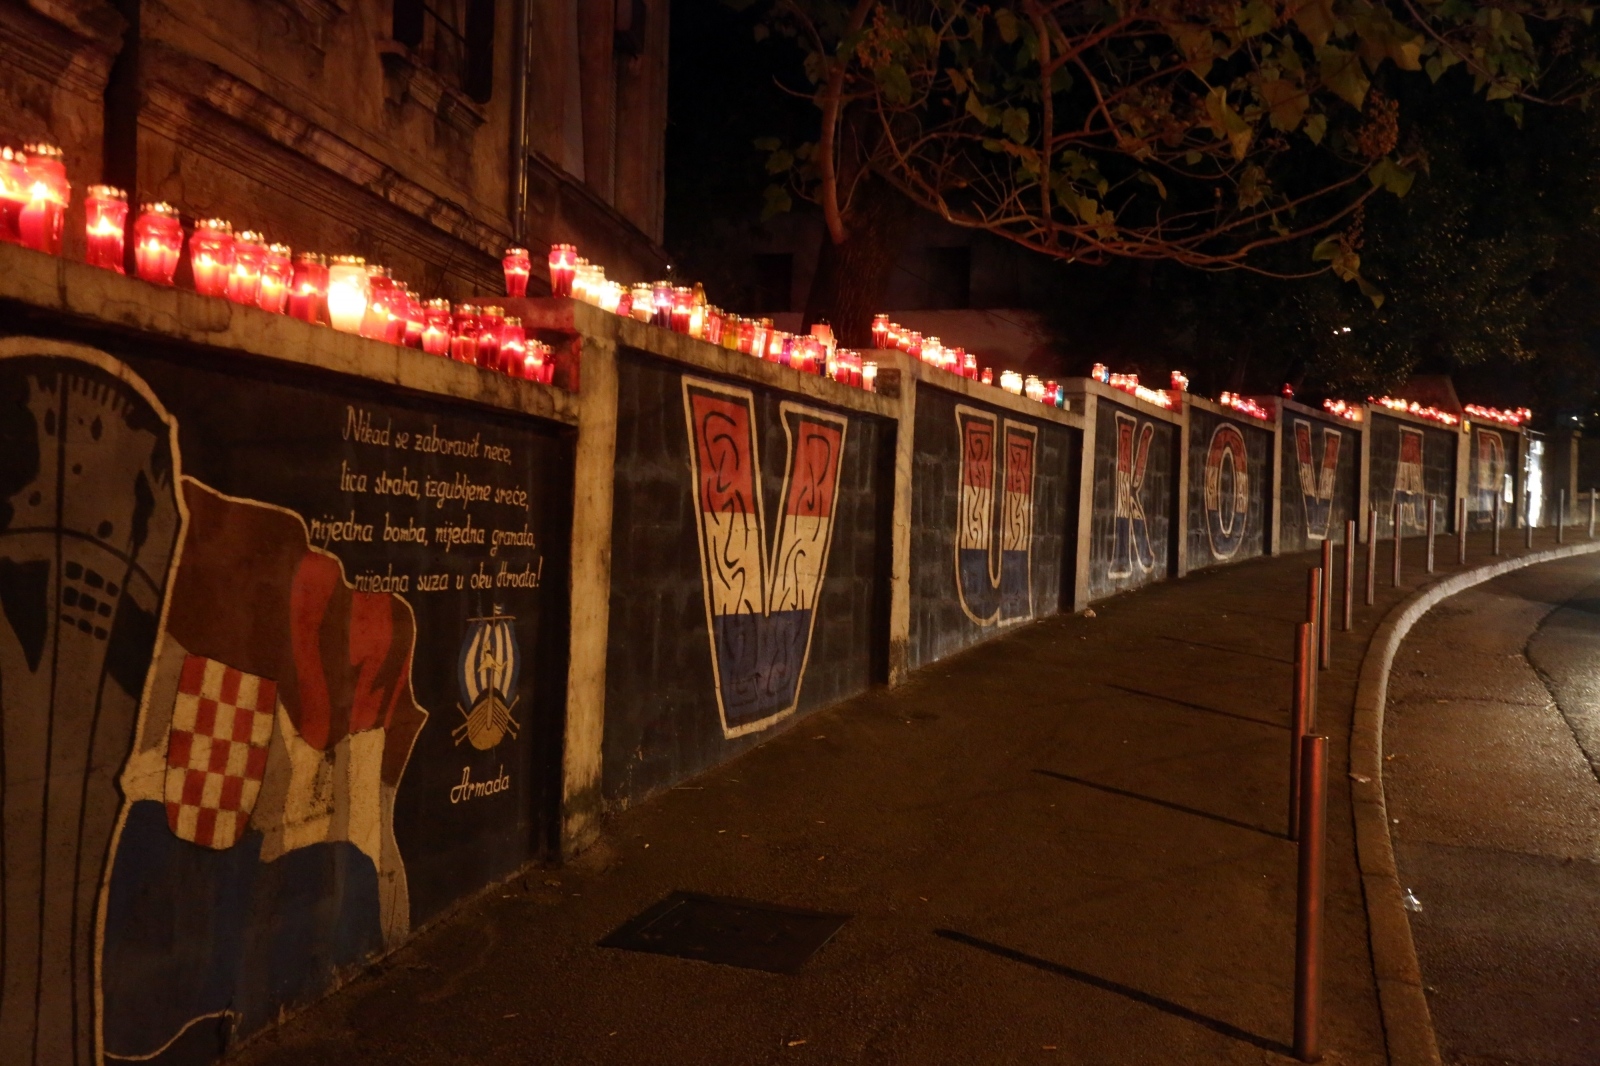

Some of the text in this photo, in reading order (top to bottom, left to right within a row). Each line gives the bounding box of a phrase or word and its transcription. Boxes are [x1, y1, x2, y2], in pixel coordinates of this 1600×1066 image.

[342, 404, 392, 446] Nikad
[395, 430, 410, 450] se
[414, 424, 481, 458] zaboravit
[339, 459, 367, 493] lica
[374, 466, 421, 499] straha,
[425, 471, 492, 510] izgubljene
[310, 509, 536, 557] nijedna bomba, nijedna granata,
[355, 562, 410, 599] nijedna
[417, 573, 449, 592] suza
[455, 574, 464, 591] u
[470, 561, 493, 590] oku
[450, 764, 510, 804] Armada
